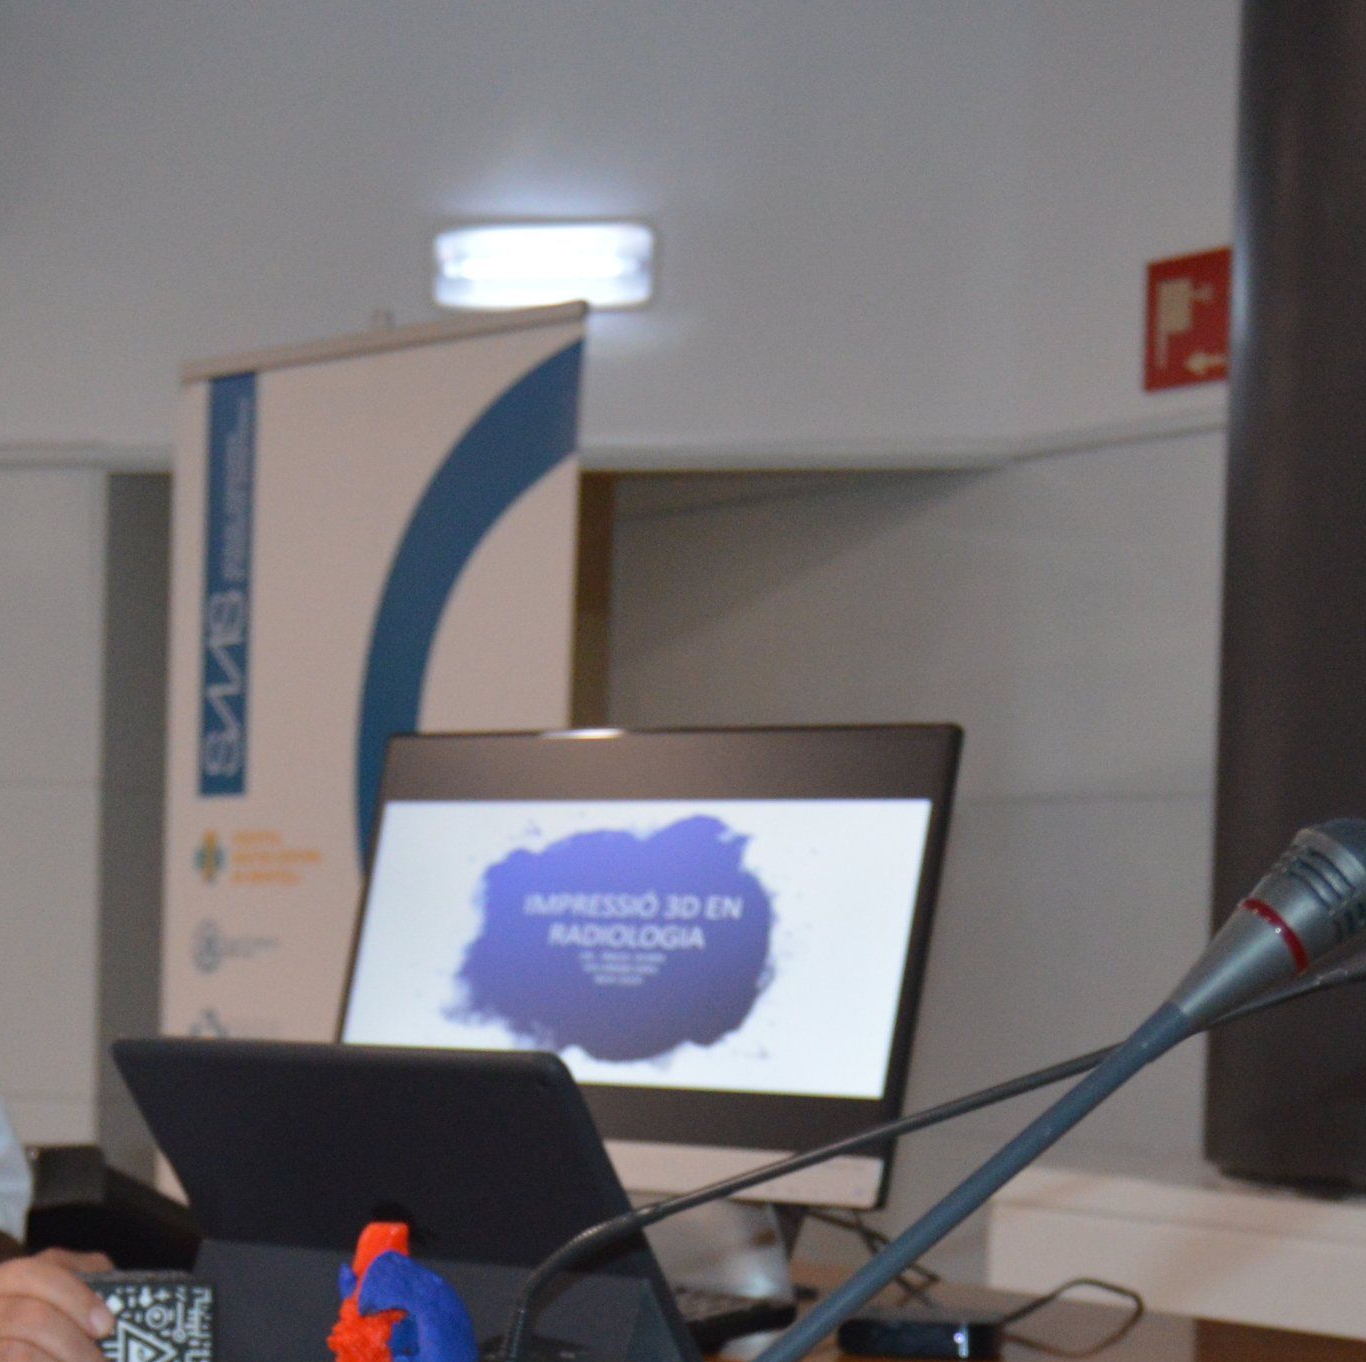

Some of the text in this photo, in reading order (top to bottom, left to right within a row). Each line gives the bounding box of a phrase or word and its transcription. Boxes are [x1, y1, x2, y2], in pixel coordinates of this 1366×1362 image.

[525, 891, 743, 920] IMPRESSIÓ 3D EN
[549, 922, 705, 948] RADIOLOGIA
